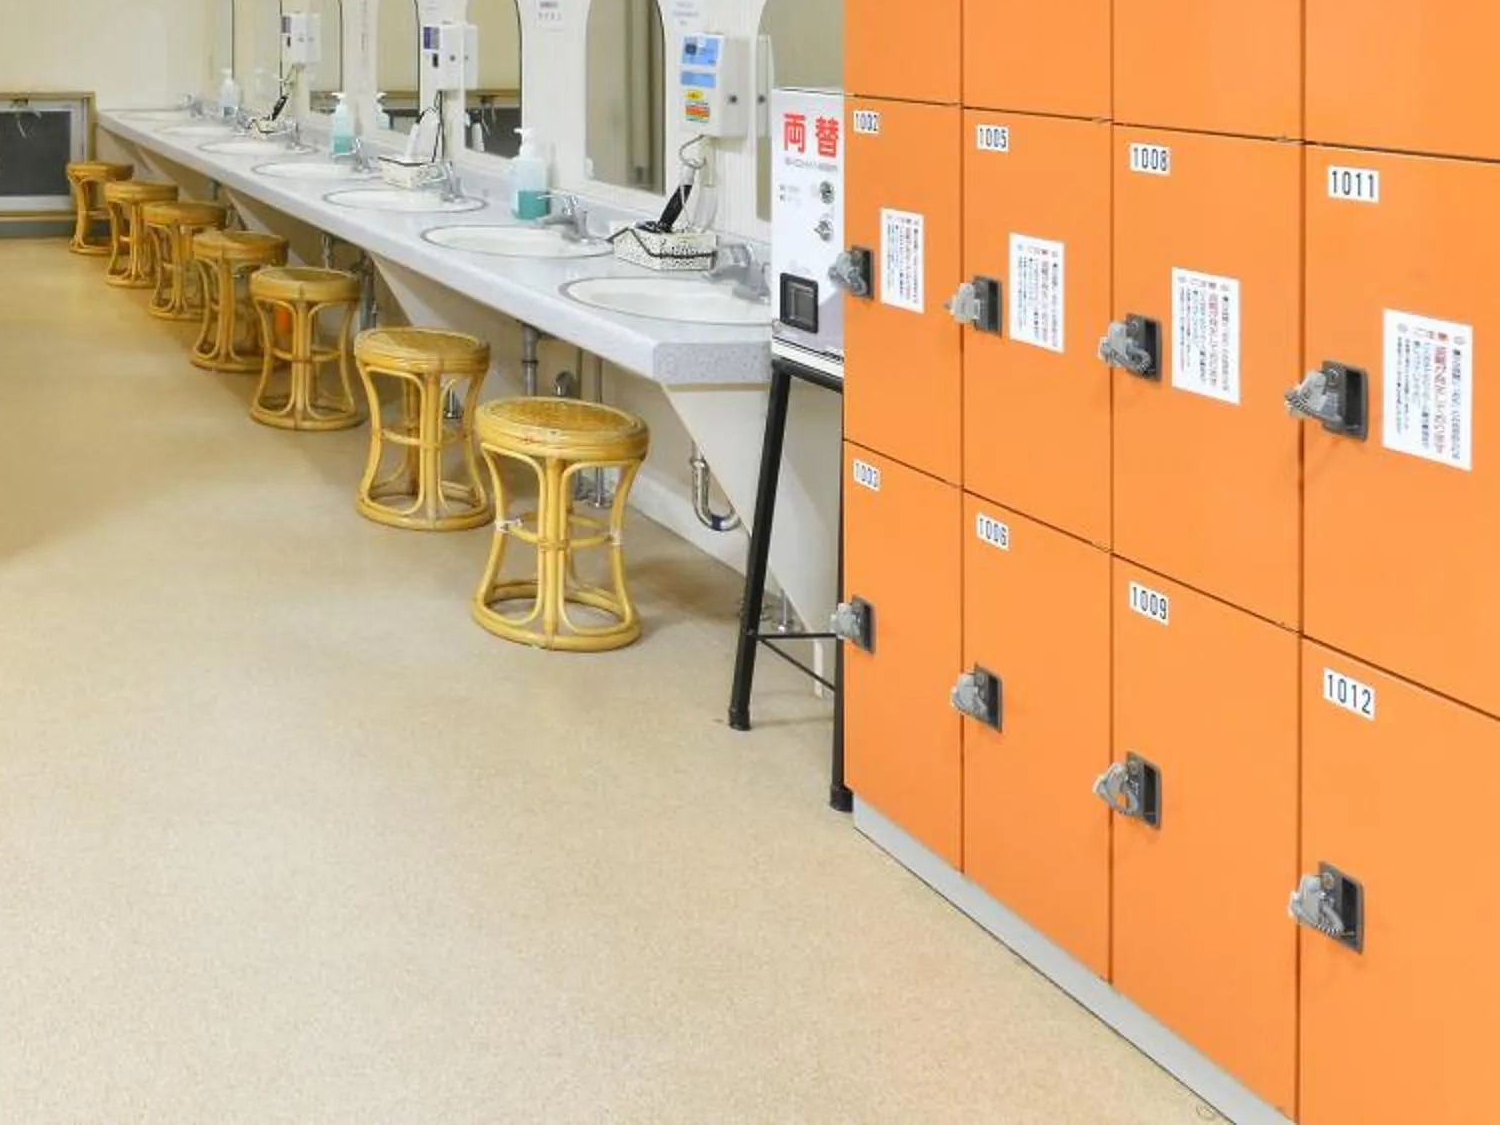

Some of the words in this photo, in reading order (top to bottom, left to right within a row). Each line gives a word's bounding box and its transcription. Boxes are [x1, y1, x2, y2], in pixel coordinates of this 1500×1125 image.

[783, 113, 840, 159] 両替
[979, 127, 1007, 150] 1005
[1133, 147, 1169, 172] 1008
[1332, 170, 1375, 199] 1011
[979, 517, 1007, 547] 1006
[1132, 586, 1168, 621] 1009
[1328, 673, 1372, 715] 1012
